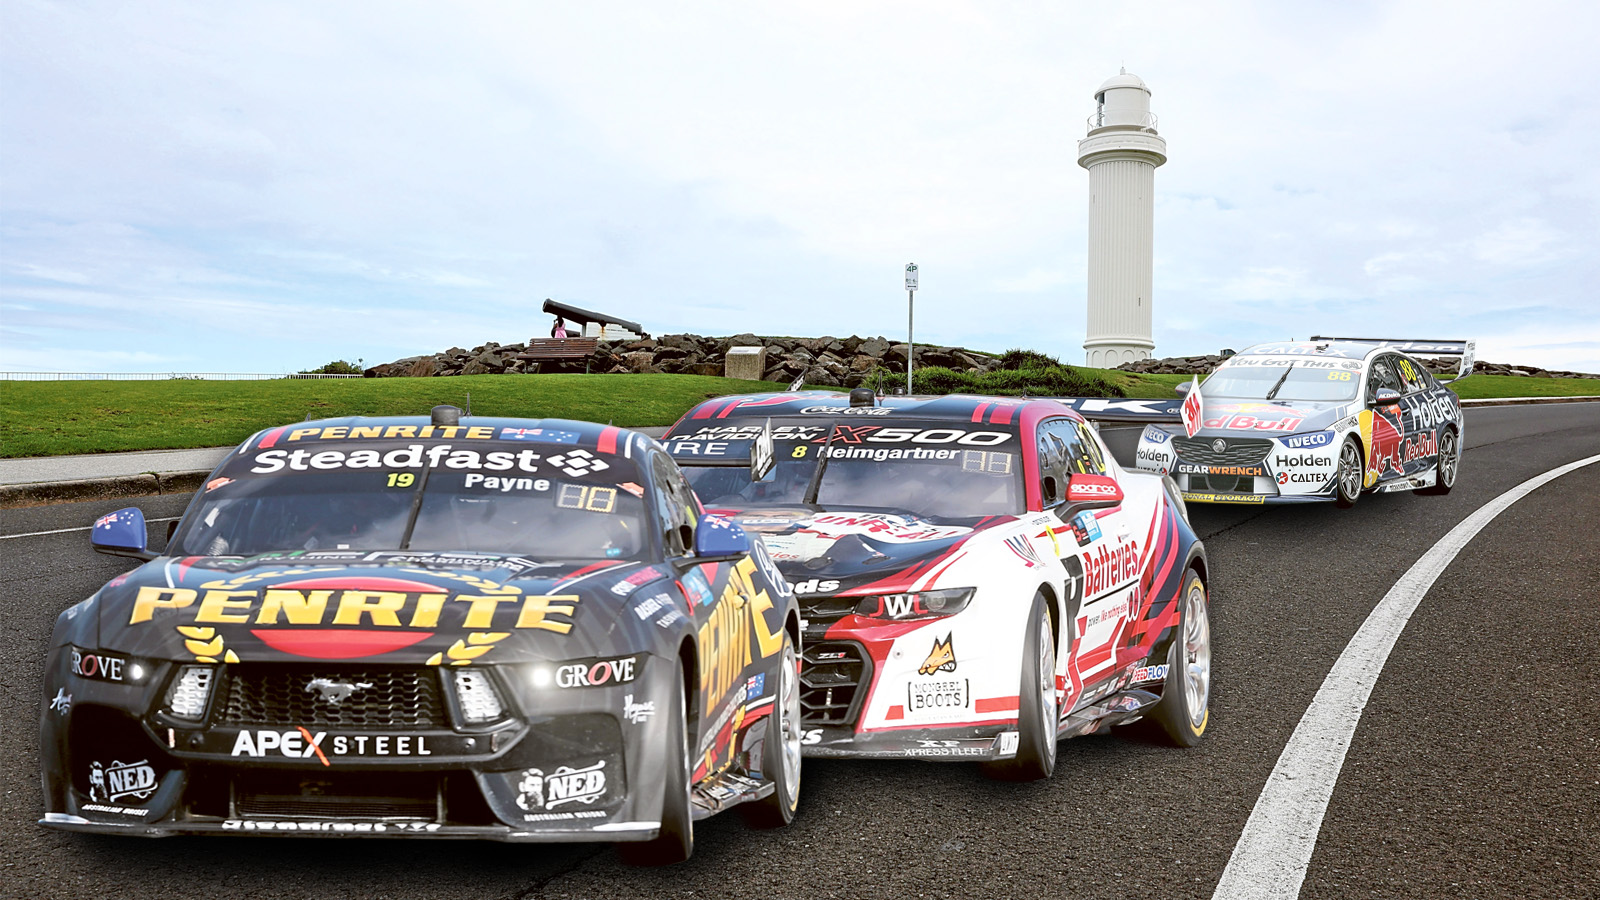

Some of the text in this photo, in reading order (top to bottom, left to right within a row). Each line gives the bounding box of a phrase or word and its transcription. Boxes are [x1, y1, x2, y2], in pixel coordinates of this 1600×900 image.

[906, 265, 918, 273] 4P
[1327, 371, 1351, 382] 88
[1399, 359, 1417, 381] 88
[287, 425, 496, 442] PENRITE
[1288, 434, 1327, 448] IVECO
[250, 444, 542, 474] Steadfast
[791, 445, 809, 459] 8
[1275, 454, 1332, 468] Holden
[1178, 464, 1263, 476] GEARWRENCH
[1290, 473, 1329, 483] CALTEX
[386, 473, 551, 492] 19 Payne
[1083, 539, 1138, 598] Batteries
[129, 586, 579, 634] PENRITE
[868, 594, 929, 617] JWL
[555, 656, 636, 689] GROVE
[914, 681, 962, 693] MONGREL
[915, 692, 961, 709] BOOTS
[231, 725, 431, 766] APEX STEEL
[904, 747, 985, 756] XPRESS FLEET
[108, 764, 156, 794] NED
[547, 769, 606, 801] NED
